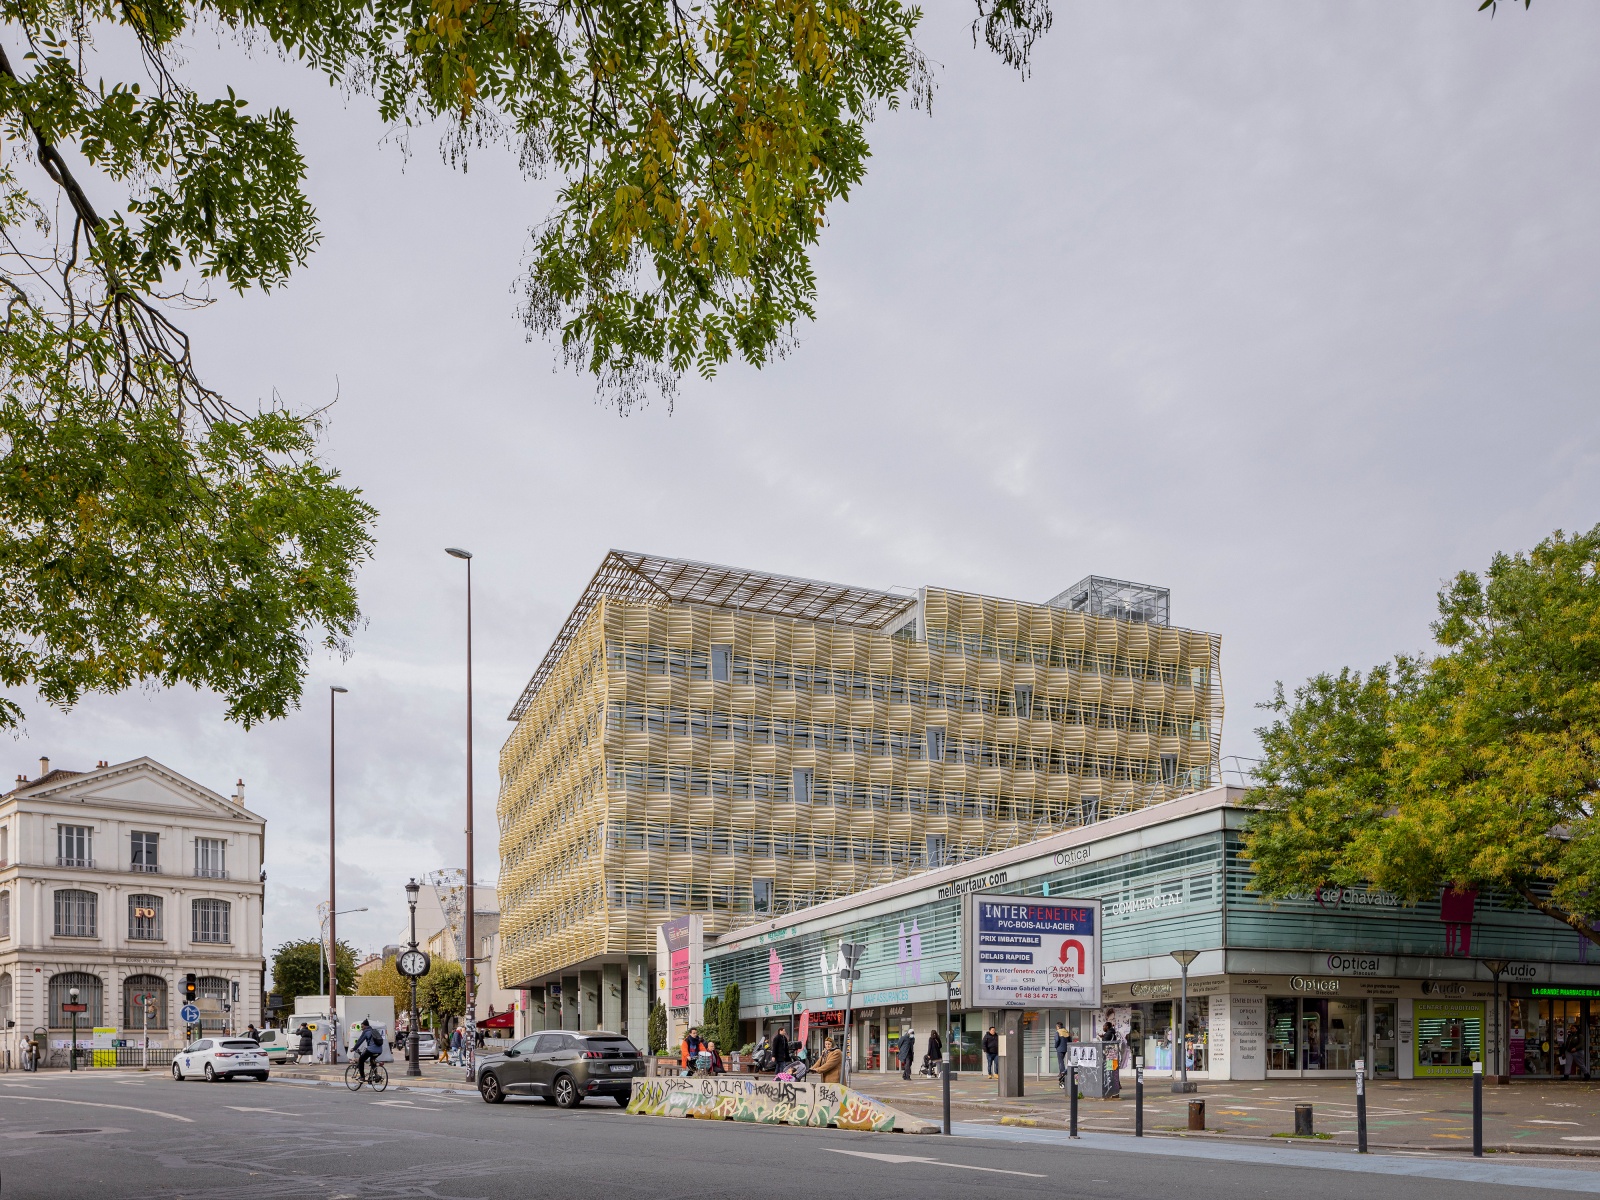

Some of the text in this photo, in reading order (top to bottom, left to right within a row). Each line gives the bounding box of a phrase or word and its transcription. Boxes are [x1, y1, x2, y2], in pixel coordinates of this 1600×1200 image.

[1056, 846, 1091, 866] Optical
[938, 871, 1008, 899] meilleurtaux.com
[1112, 892, 1183, 915] COMMERCIAL
[1342, 889, 1398, 906] Chavaux
[134, 907, 155, 918] FO
[985, 904, 1087, 922] INTERFENETRE
[998, 920, 1075, 931] PVC-BOIS-ALU-ACIER
[997, 936, 1040, 944] IMBATTABLE
[1331, 956, 1380, 971] Optical
[1501, 964, 1537, 977] Audio
[983, 967, 1048, 975] www.interfenetre.com
[1291, 976, 1340, 992] Optical
[1431, 981, 1467, 995] Audio
[876, 989, 909, 1003] ASSURANCES
[1539, 988, 1559, 996] GRANDE
[1559, 989, 1586, 997] PHARMACIE
[1586, 989, 1593, 997] DE
[888, 1007, 905, 1016] MAAF
